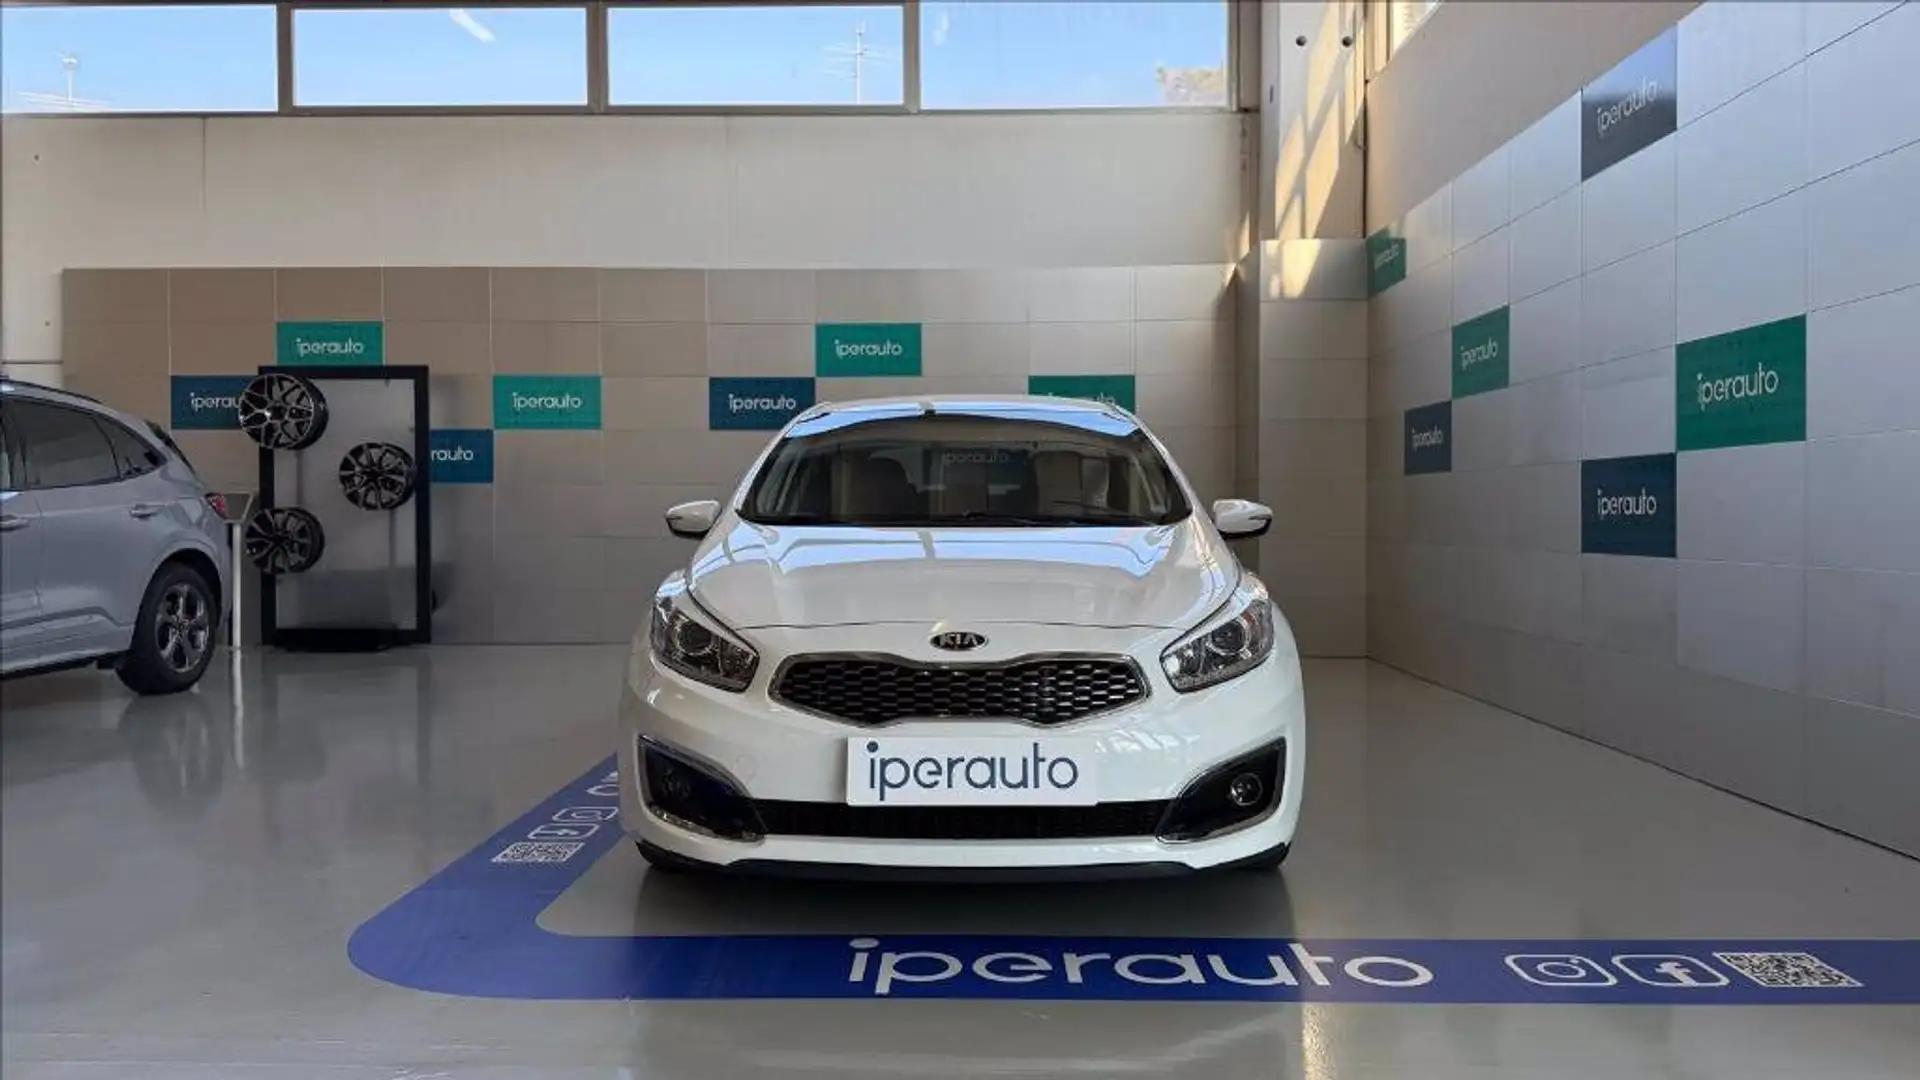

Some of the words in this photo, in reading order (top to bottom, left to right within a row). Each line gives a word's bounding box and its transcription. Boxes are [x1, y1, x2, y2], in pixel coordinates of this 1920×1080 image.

[1596, 77, 1658, 138] iperauto
[296, 337, 364, 356] iperauto
[835, 339, 903, 358] iperauto
[1460, 337, 1499, 371] iperauto
[512, 392, 582, 411] iperauto
[1697, 362, 1780, 411] iperauto
[728, 393, 797, 412] iperauto
[1597, 487, 1658, 518] iperauto
[939, 633, 978, 646] KIA
[866, 740, 1079, 802] iperauto
[848, 938, 1434, 995] iperauto
